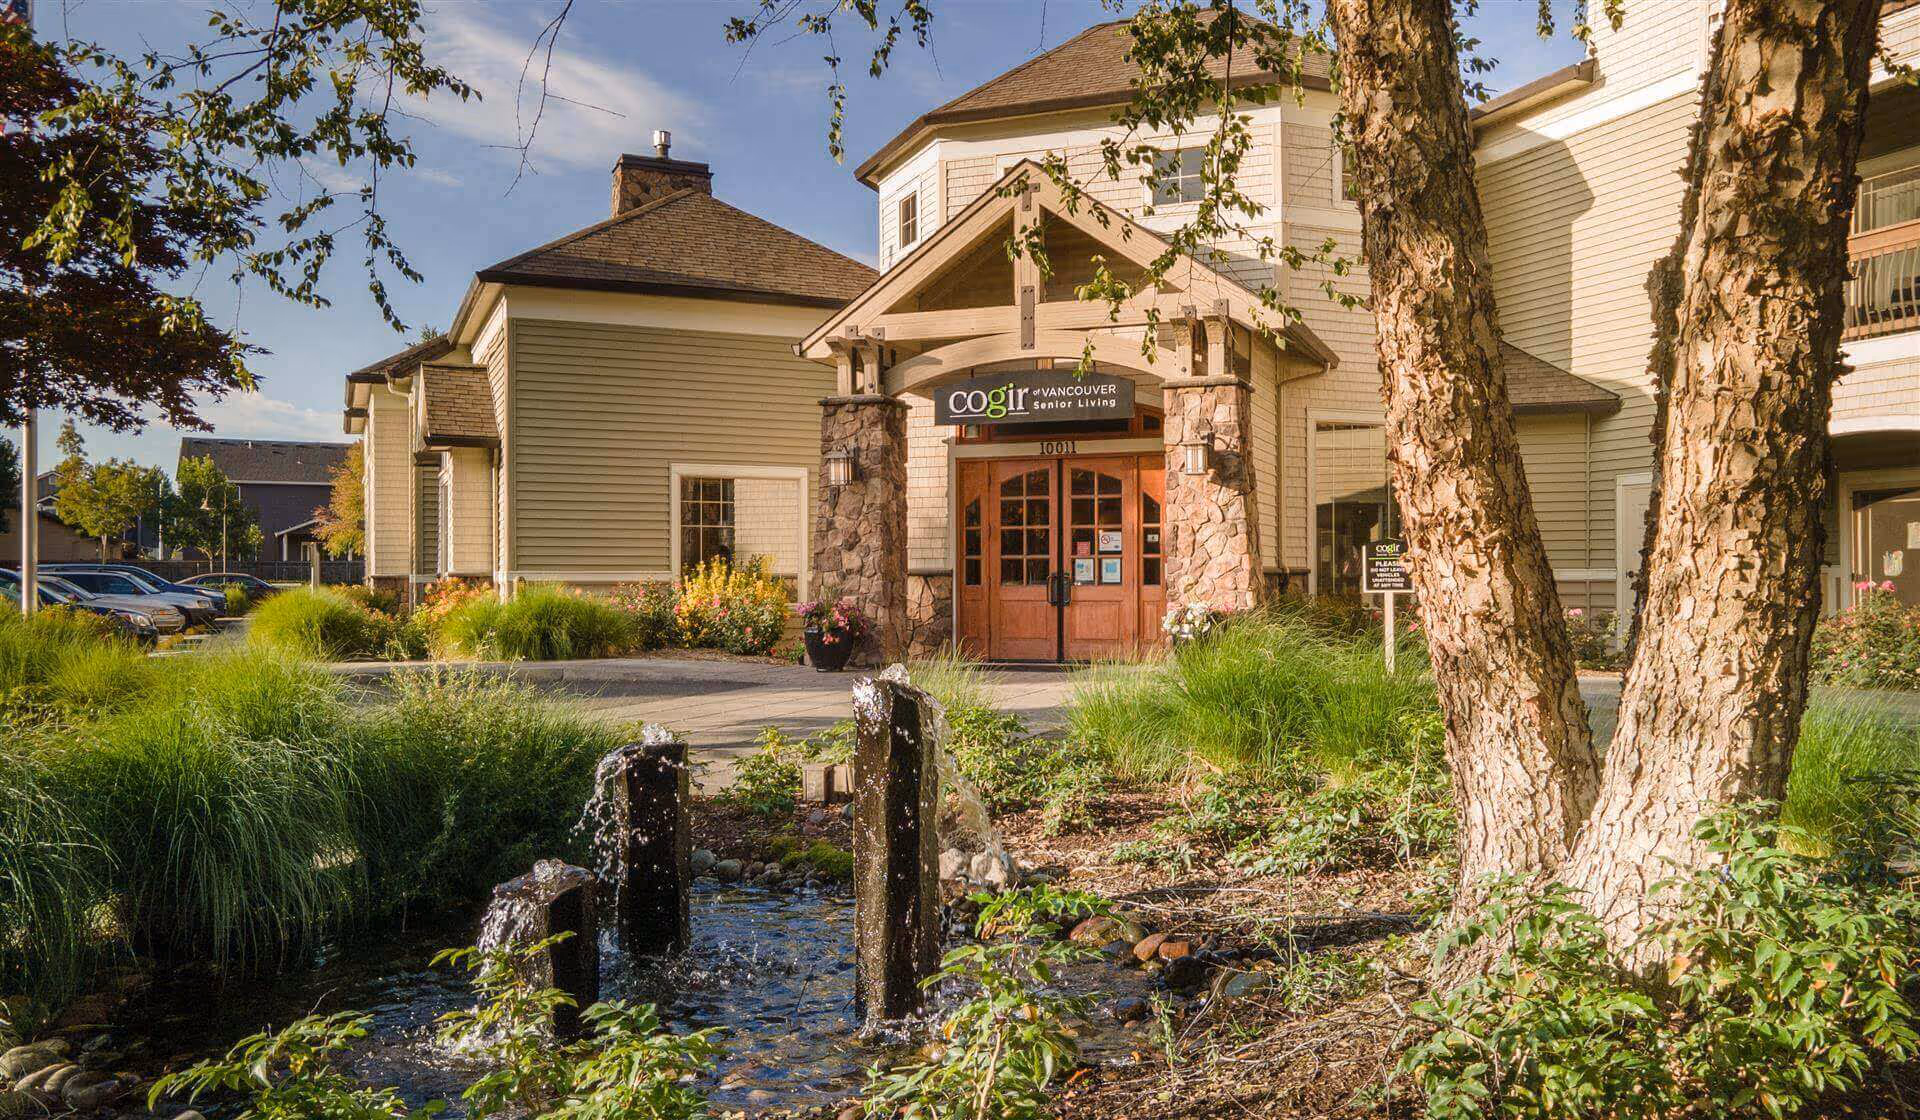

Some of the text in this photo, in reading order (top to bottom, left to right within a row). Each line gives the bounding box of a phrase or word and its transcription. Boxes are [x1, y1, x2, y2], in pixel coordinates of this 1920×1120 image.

[1032, 384, 1117, 397] of VANCOUVER
[949, 383, 1029, 418] cogir
[1033, 398, 1117, 410] Senior Living
[1039, 441, 1077, 455] 10011
[1375, 543, 1401, 554] cogir
